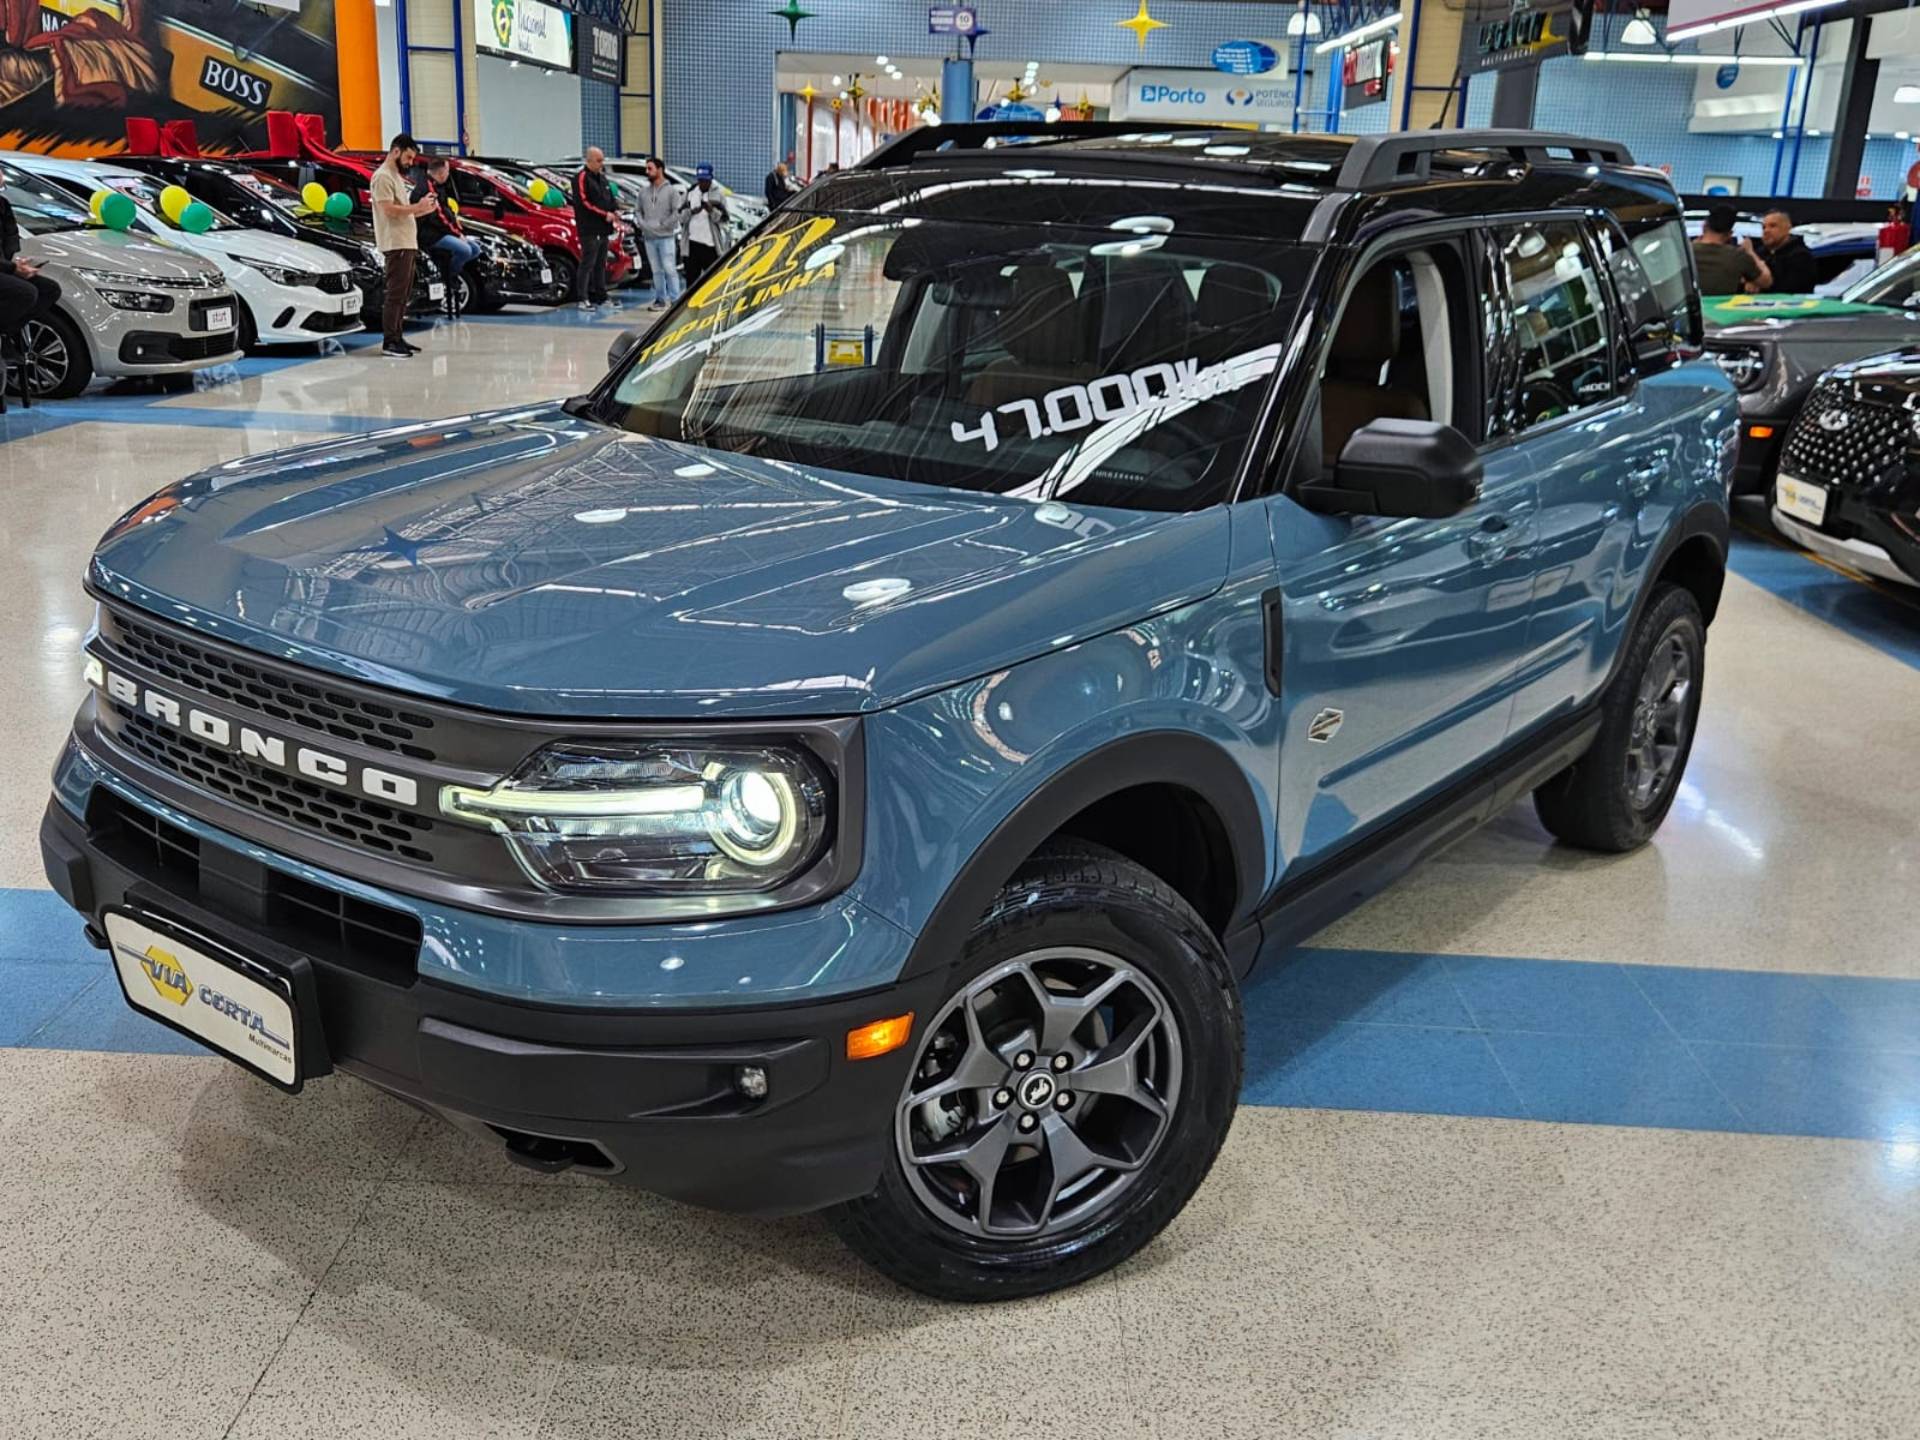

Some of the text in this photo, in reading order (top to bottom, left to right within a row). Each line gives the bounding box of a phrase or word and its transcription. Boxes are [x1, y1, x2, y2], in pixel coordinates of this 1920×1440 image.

[204, 60, 266, 105] BOSS
[1158, 86, 1206, 104] Porto
[639, 319, 698, 364] TOP
[733, 262, 835, 314] LINHA
[107, 671, 418, 806] BRONCO
[151, 960, 188, 994] VIA
